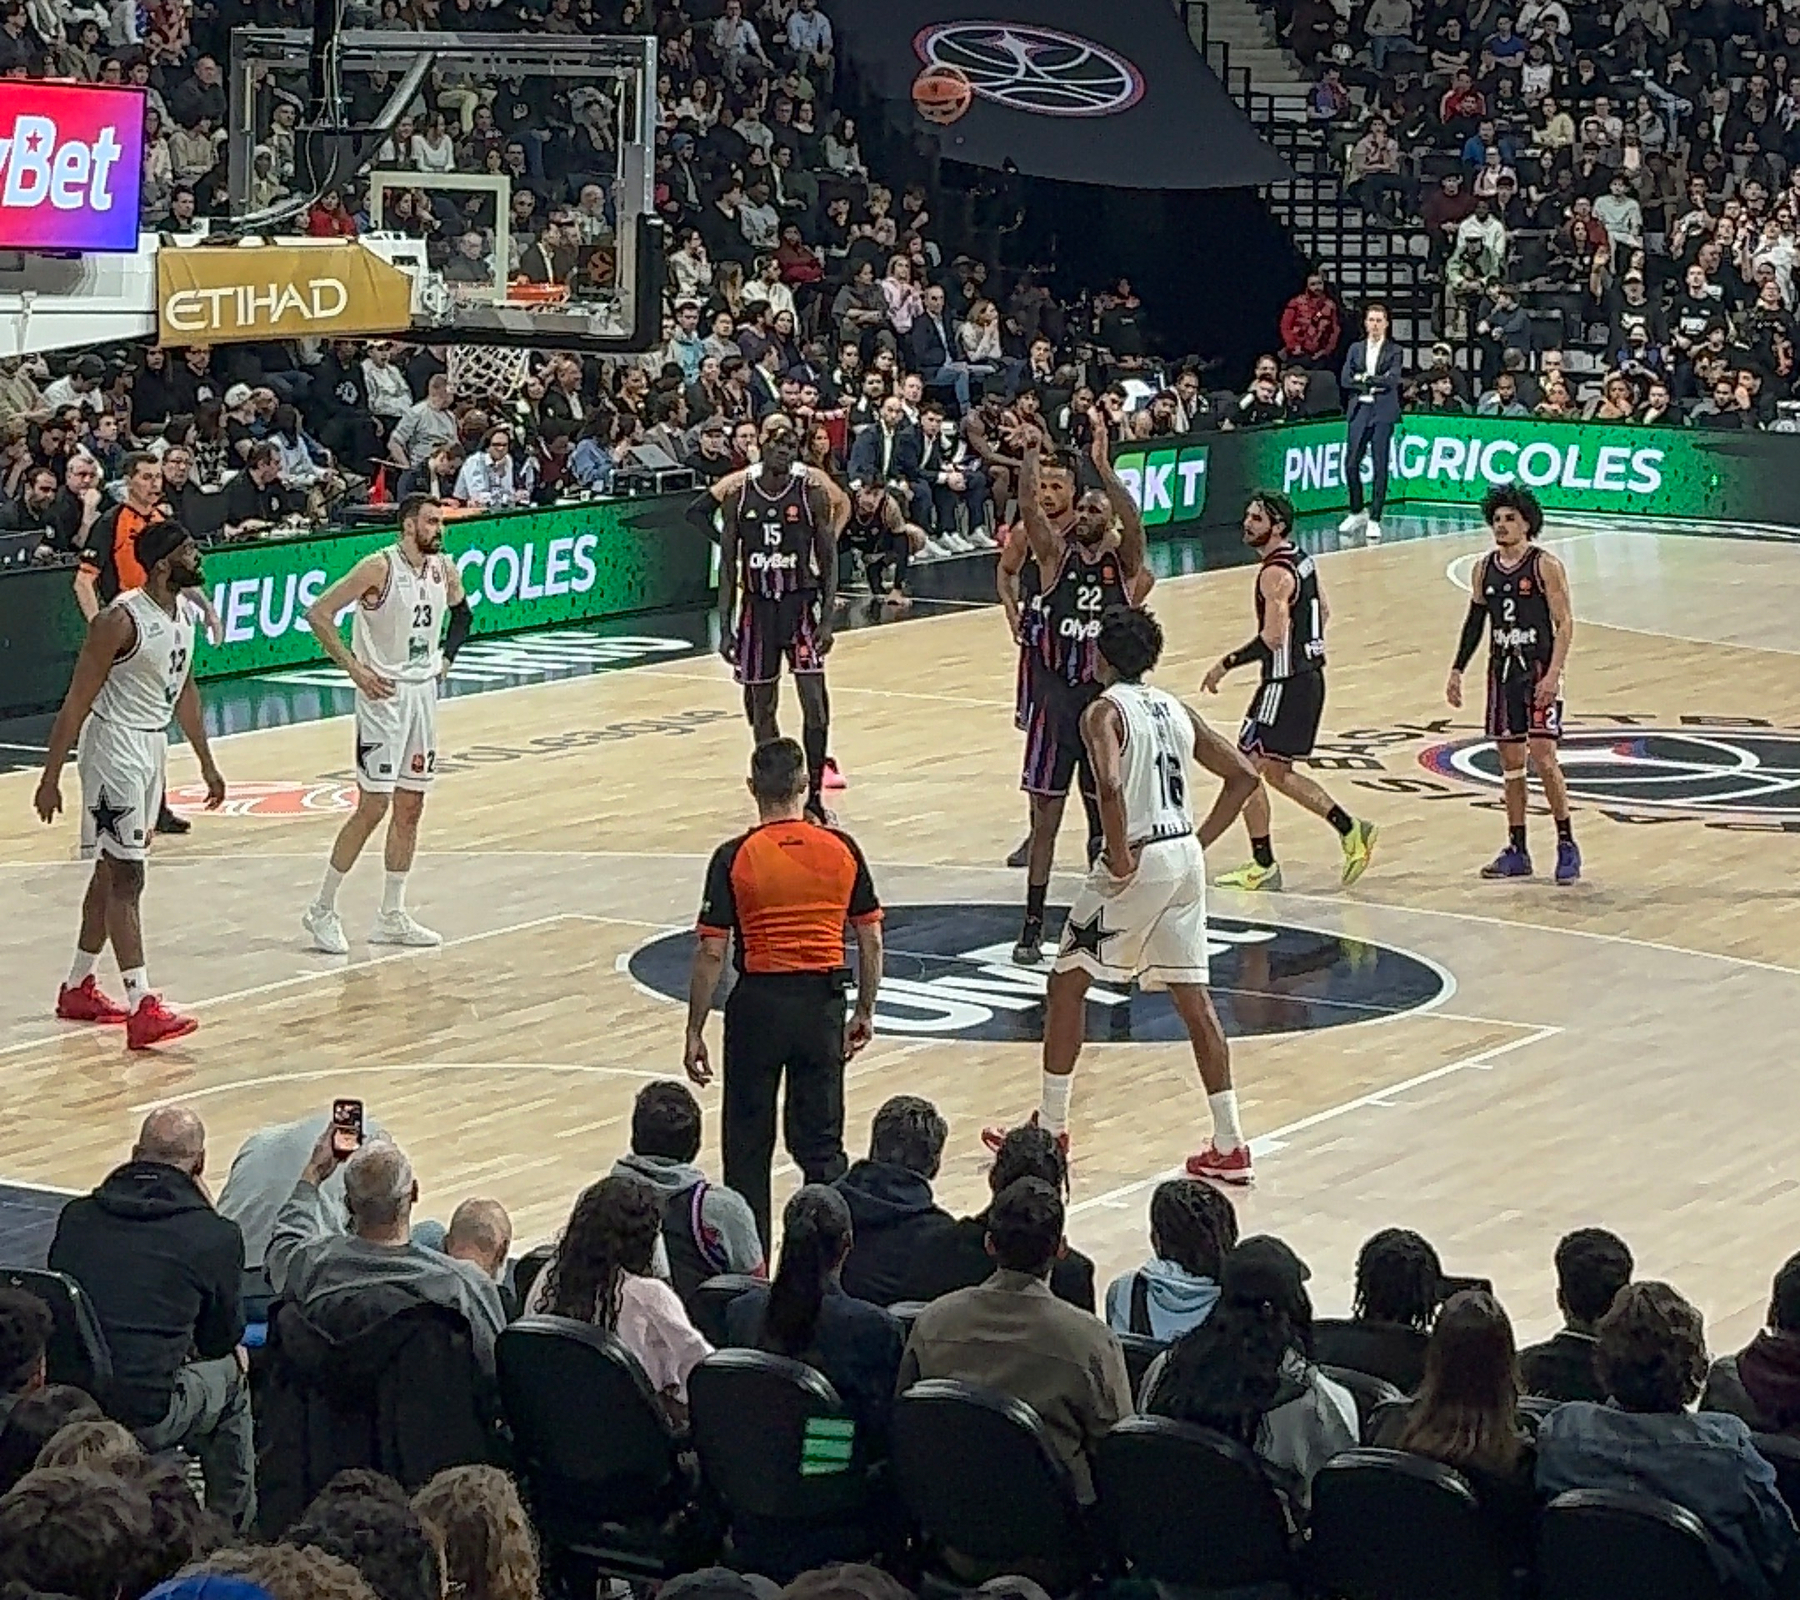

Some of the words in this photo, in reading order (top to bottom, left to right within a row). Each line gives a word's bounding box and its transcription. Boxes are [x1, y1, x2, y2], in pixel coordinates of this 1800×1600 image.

[166, 278, 348, 331] ETIHAD
[762, 522, 782, 546] 15
[1077, 586, 1102, 612] 22
[1502, 597, 1516, 622] 2
[412, 604, 432, 629] 23
[1060, 618, 1103, 640] OlyB
